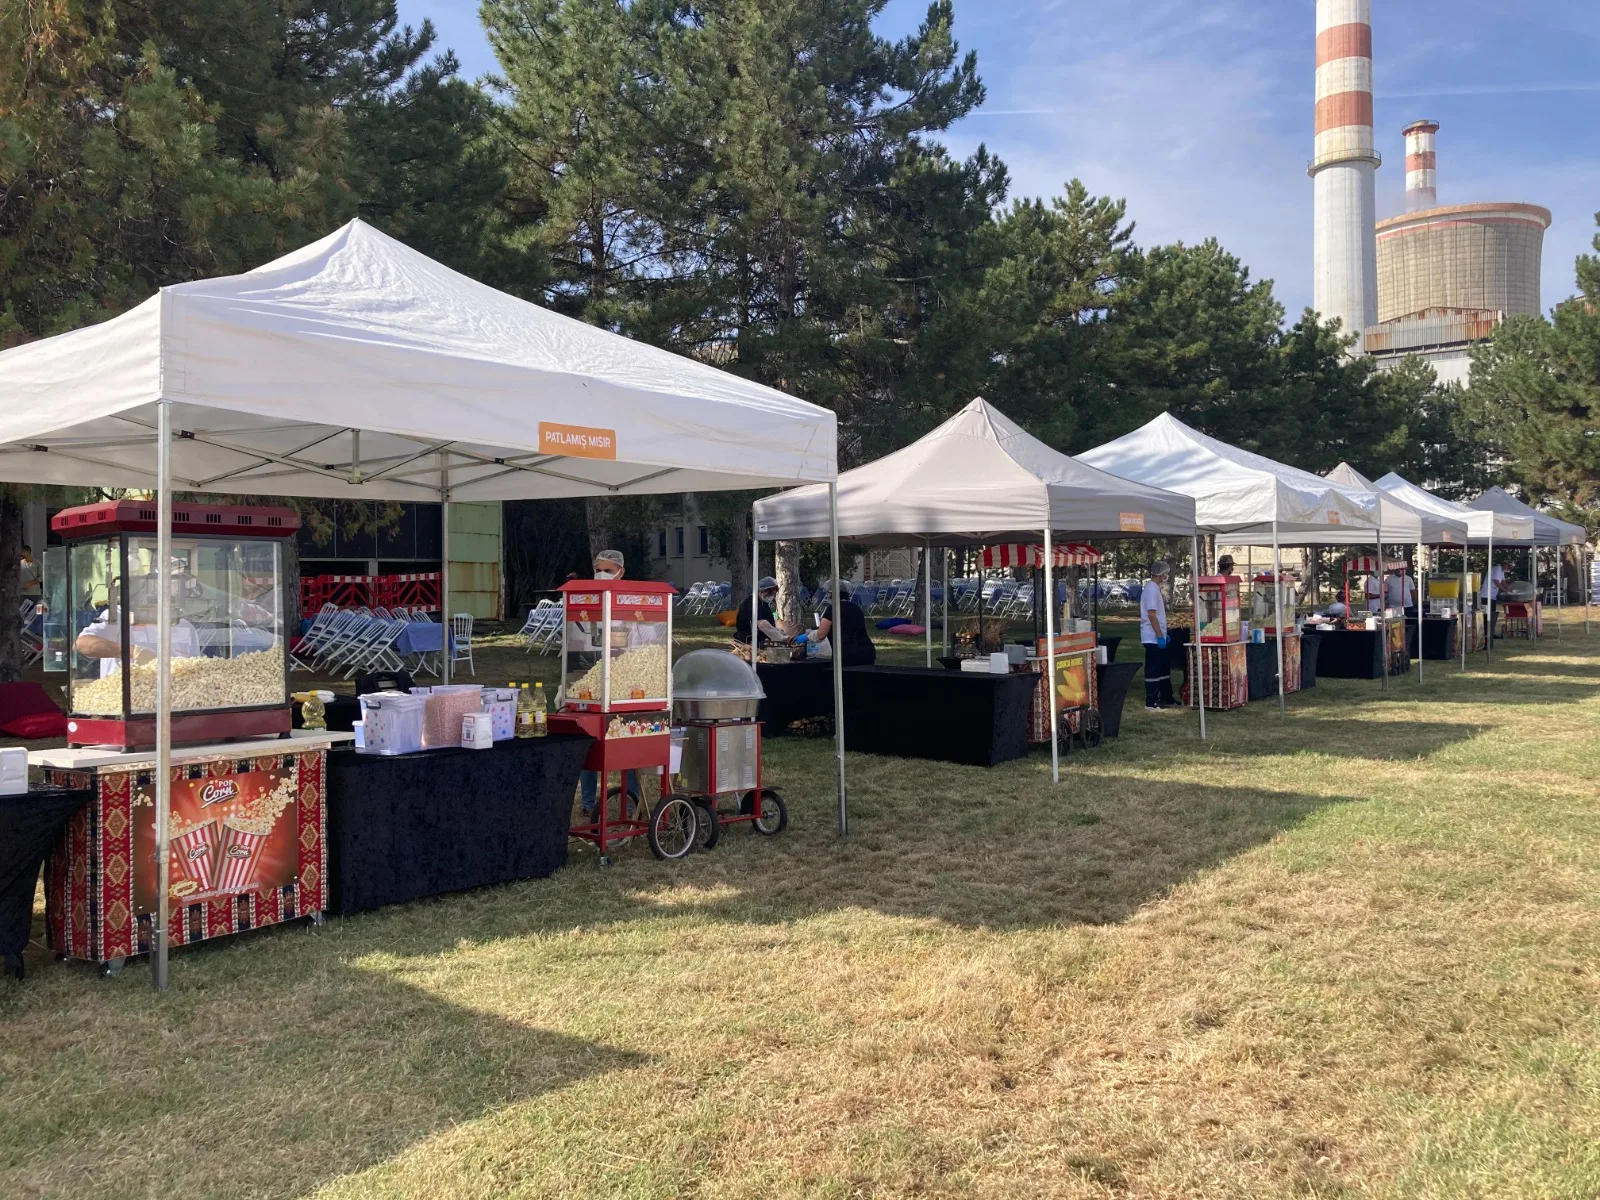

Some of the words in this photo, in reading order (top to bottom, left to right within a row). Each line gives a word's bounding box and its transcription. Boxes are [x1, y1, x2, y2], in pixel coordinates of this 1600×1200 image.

[545, 431, 587, 449] PATLAMIŞ
[588, 436, 611, 448] MISIR
[218, 780, 234, 788] POP
[203, 785, 234, 802] Corn
